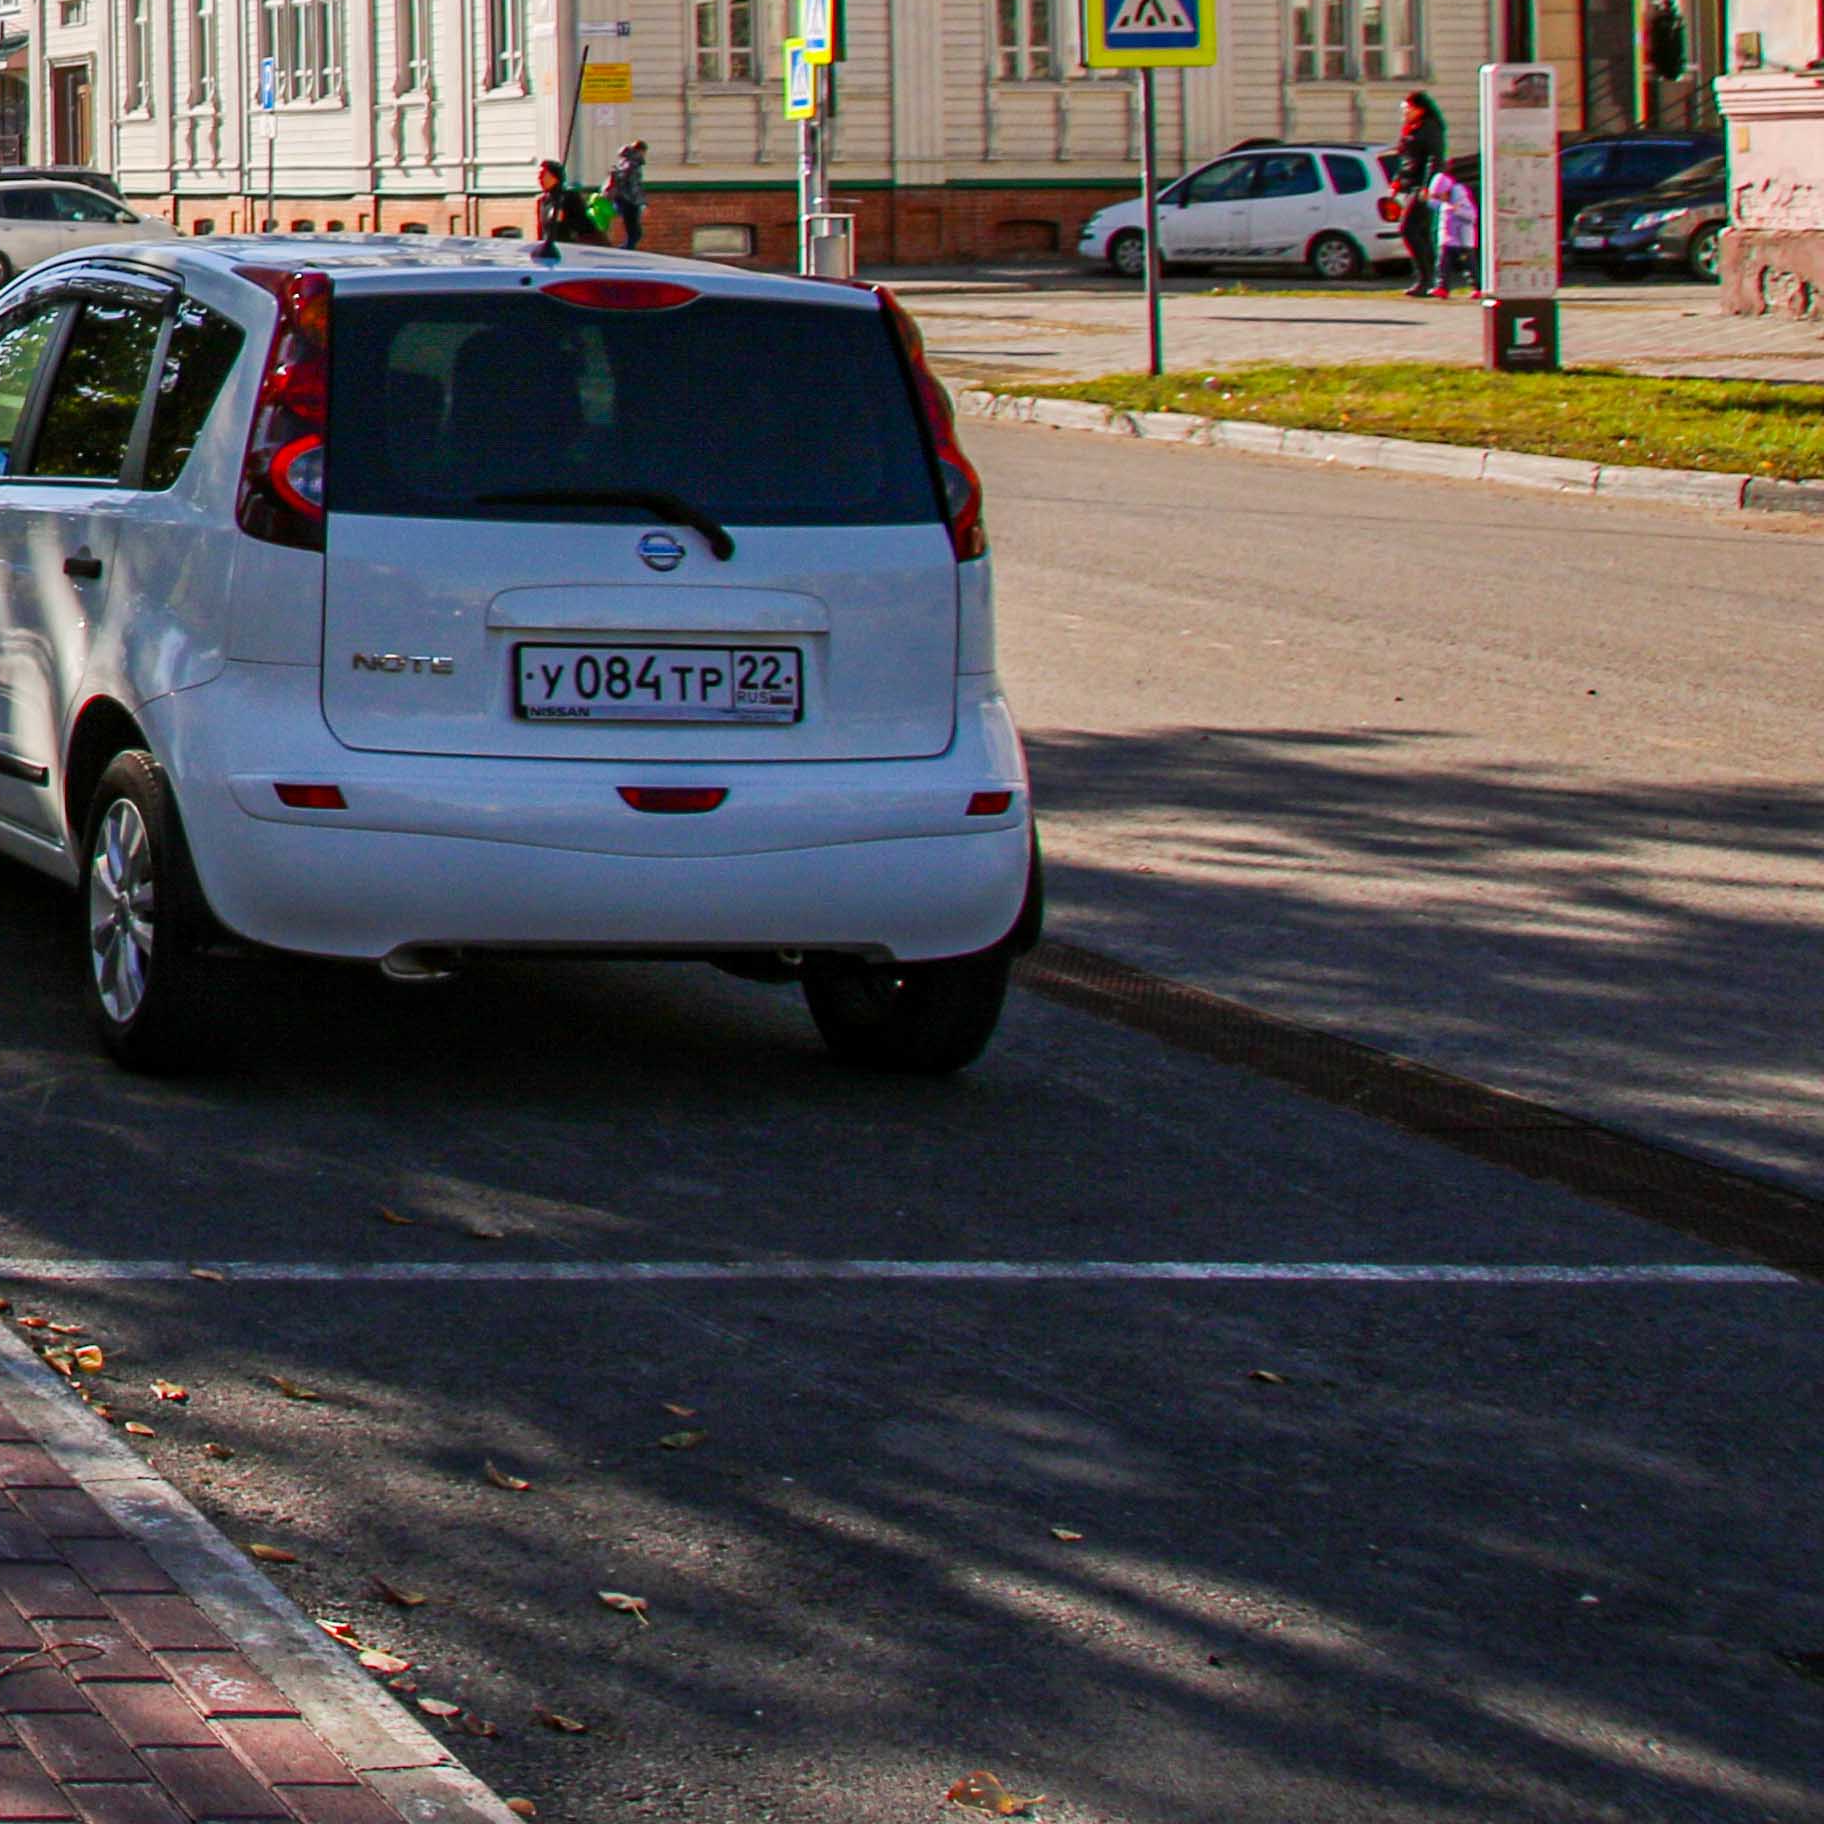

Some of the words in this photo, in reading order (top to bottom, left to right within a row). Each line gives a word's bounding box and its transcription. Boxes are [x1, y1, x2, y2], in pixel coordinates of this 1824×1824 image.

[352, 652, 453, 675] NOTE
[738, 655, 782, 690] 22
[736, 690, 769, 705] RUS
[529, 705, 591, 718] NISSAN
